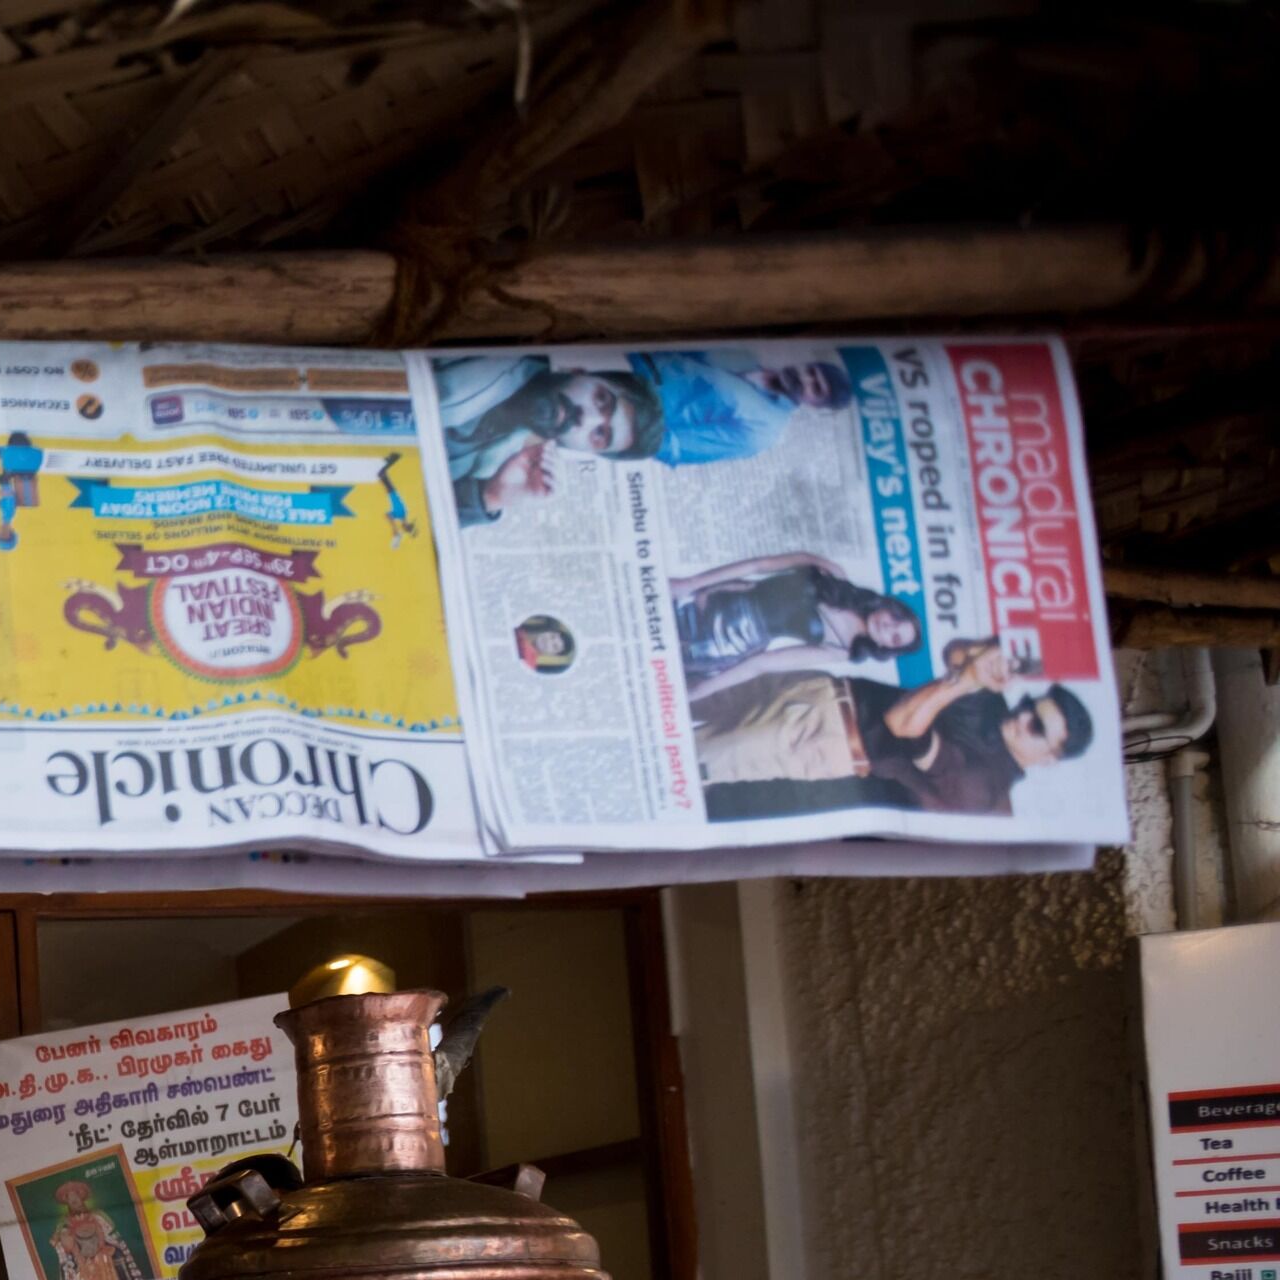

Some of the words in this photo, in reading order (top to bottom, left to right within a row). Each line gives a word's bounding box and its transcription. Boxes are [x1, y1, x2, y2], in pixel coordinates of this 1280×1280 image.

[5, 365, 39, 375] COST
[44, 366, 65, 376] NO
[898, 346, 933, 389] VS
[2, 397, 71, 412] EXCHANGE
[340, 408, 383, 429] 10%
[858, 372, 908, 498] Vijay's
[157, 453, 194, 469] FAST
[199, 452, 232, 464] FREE
[231, 459, 306, 473] UNLIMITED
[909, 401, 943, 510] roped
[309, 463, 337, 474] GET
[134, 482, 216, 502] MEMBERS
[220, 482, 260, 504] PRIME
[264, 494, 292, 508] FOR
[627, 471, 648, 529] Simbu
[100, 502, 158, 516] TODAY
[161, 498, 208, 516] NOON
[235, 500, 285, 520] STARTS
[289, 507, 326, 522] SALE
[962, 358, 1042, 663] CHRONICLE
[1012, 389, 1088, 622] madurai
[146, 531, 160, 540] OF
[164, 524, 223, 540] MILLIONS
[928, 522, 952, 560] in
[637, 539, 651, 562] to
[882, 507, 917, 596] next
[145, 555, 189, 573] OCT
[170, 576, 282, 603] FESTIVAL
[933, 571, 960, 629] for
[187, 598, 275, 624] INDIAN
[641, 570, 663, 652] kickstart
[202, 619, 271, 641] GREAT
[652, 659, 681, 755] political
[660, 739, 692, 810] party?
[46, 738, 434, 836] Chronicle
[207, 791, 342, 826] DECCAN
[35, 1035, 102, 1063] பேனர்
[109, 1013, 218, 1050] விவகாரம்
[117, 1044, 204, 1078] பிரமுகர்
[212, 1036, 273, 1061] கைது
[74, 1085, 159, 1117] அதிகாரி
[166, 1066, 276, 1099] சஸ்பெண்ட்
[120, 1103, 209, 1141] தேர்வில்
[215, 1103, 229, 1121] 7
[238, 1093, 281, 1118] பேர்
[134, 1120, 287, 1166] ஆள்மாறாட்டம்
[1200, 1138, 1233, 1150] Tea
[1203, 1167, 1265, 1182] Coffee
[1205, 1198, 1269, 1214] Health
[1208, 1235, 1273, 1250] Snacks
